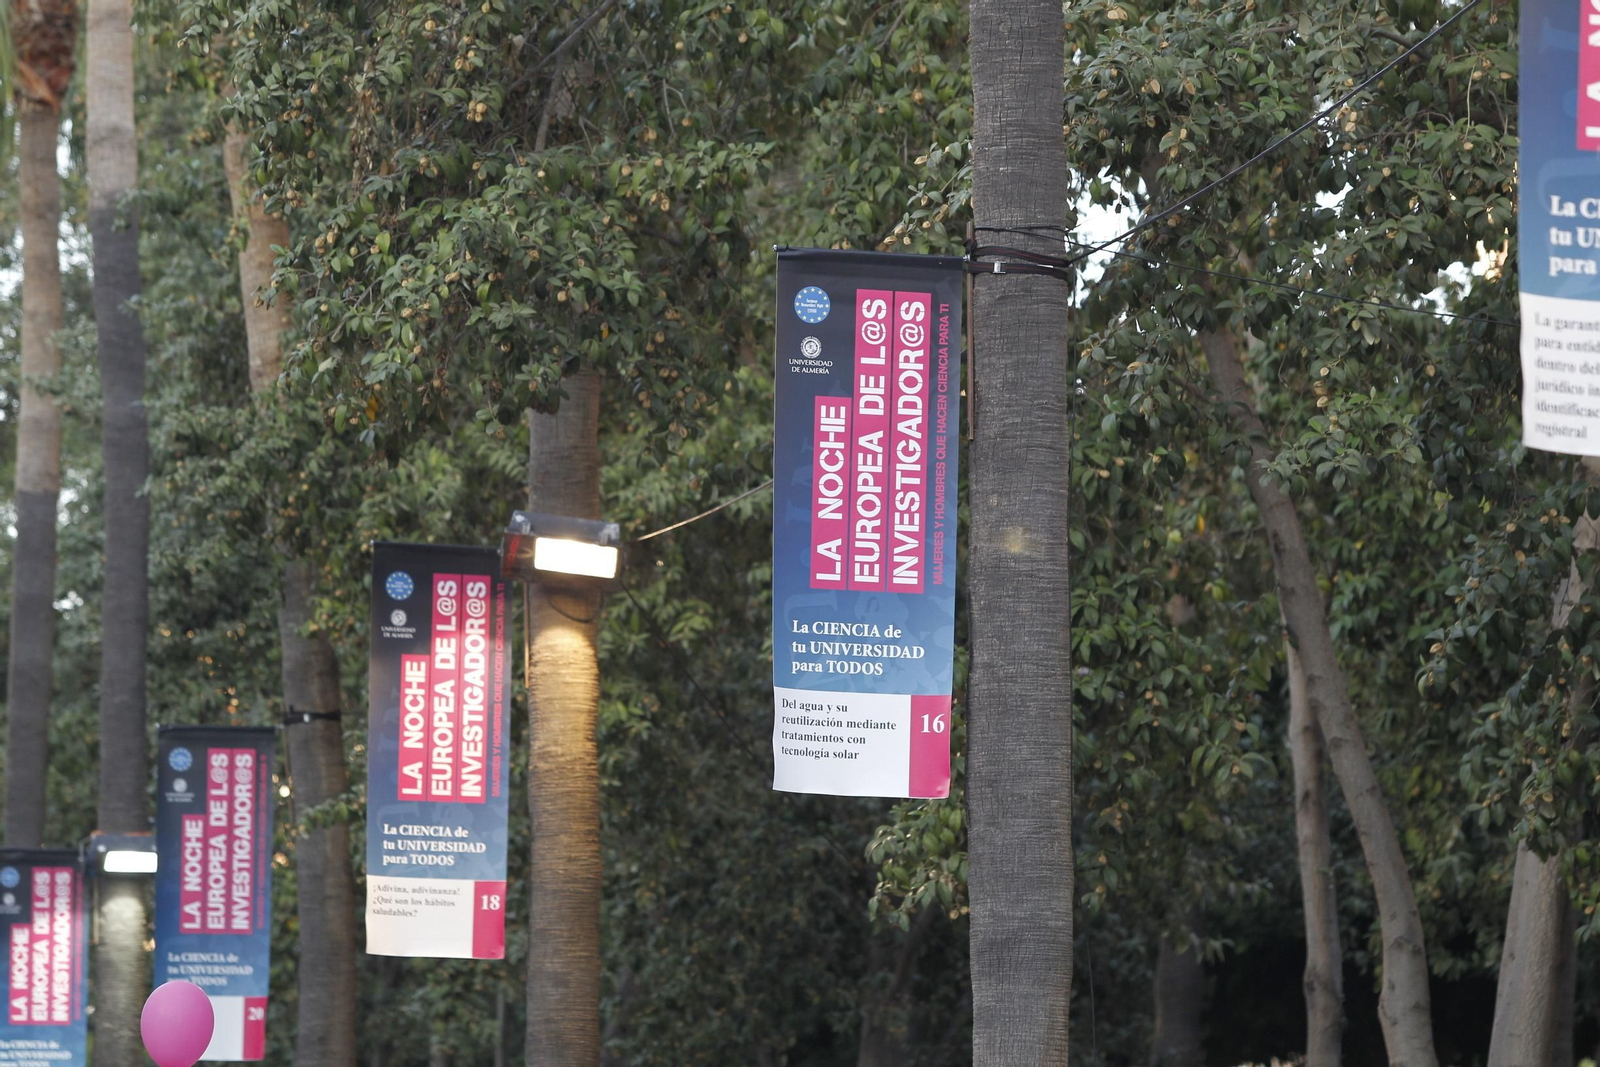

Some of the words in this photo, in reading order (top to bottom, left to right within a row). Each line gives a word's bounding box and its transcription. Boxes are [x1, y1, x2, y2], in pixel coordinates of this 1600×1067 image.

[1549, 194, 1577, 217] La
[1549, 226, 1573, 246] tu
[1548, 256, 1598, 277] para
[940, 303, 949, 314] TI
[860, 298, 887, 365] L@S
[939, 316, 949, 345] PARA
[788, 358, 833, 368] UNIVERSIDAD
[801, 366, 830, 374] ALMERÍA
[937, 347, 949, 393] CIENCIA
[859, 374, 885, 416] DE
[936, 395, 948, 433] HACEN
[892, 301, 926, 585] INVESTIGADOR@S
[936, 435, 947, 460] QUE
[817, 405, 846, 520] NOCHE
[935, 462, 946, 519] HOMBRES
[854, 430, 884, 583] EUROPEA
[934, 521, 945, 529] Y
[816, 538, 842, 581] LA
[933, 531, 944, 585] MUJERES
[436, 580, 457, 631] L@S
[792, 619, 809, 634] La
[812, 621, 881, 638] CIENCIA
[884, 624, 902, 639] de
[434, 637, 456, 670] DE
[792, 641, 806, 653] tu
[810, 641, 925, 659] UNIVERSIDAD
[791, 661, 823, 675] para
[826, 660, 883, 675] TODOS
[460, 581, 487, 797] INVESTIGADOR@S
[403, 660, 426, 749] NOCHE
[782, 698, 797, 709] Del
[799, 701, 824, 713] agua
[826, 703, 833, 714] y
[836, 704, 848, 713] su
[782, 715, 843, 728] reutilización
[846, 719, 897, 730] mediante
[920, 713, 945, 734] 16
[431, 679, 456, 796] EUROPEA
[782, 731, 844, 743] tratamientos
[847, 735, 866, 744] con
[781, 745, 830, 760] tecnología
[832, 748, 860, 760] solar
[210, 753, 229, 796] L@S
[402, 761, 423, 795] LA
[209, 800, 228, 827] DE
[231, 753, 253, 930] INVESTIGADOR@S
[383, 823, 397, 835] La
[399, 824, 453, 838] CIENCIA
[454, 826, 469, 838] de
[184, 819, 204, 891] NOCHE
[383, 840, 395, 850] tu
[397, 840, 486, 853] UNIVERSIDAD
[382, 854, 408, 866] para
[409, 854, 455, 866] TODOS
[207, 834, 227, 929] EUROPEA
[395, 897, 409, 905] son
[411, 896, 422, 905] los
[481, 894, 500, 911] 18
[32, 911, 50, 935] DE
[183, 900, 201, 929] LA
[12, 927, 30, 990] NOCHE
[179, 964, 254, 975] UNIVERSIDAD
[181, 952, 226, 963] CIENCIA
[31, 938, 50, 1021] EUROPEA
[11, 996, 28, 1021] LA
[248, 1006, 265, 1021] 20
